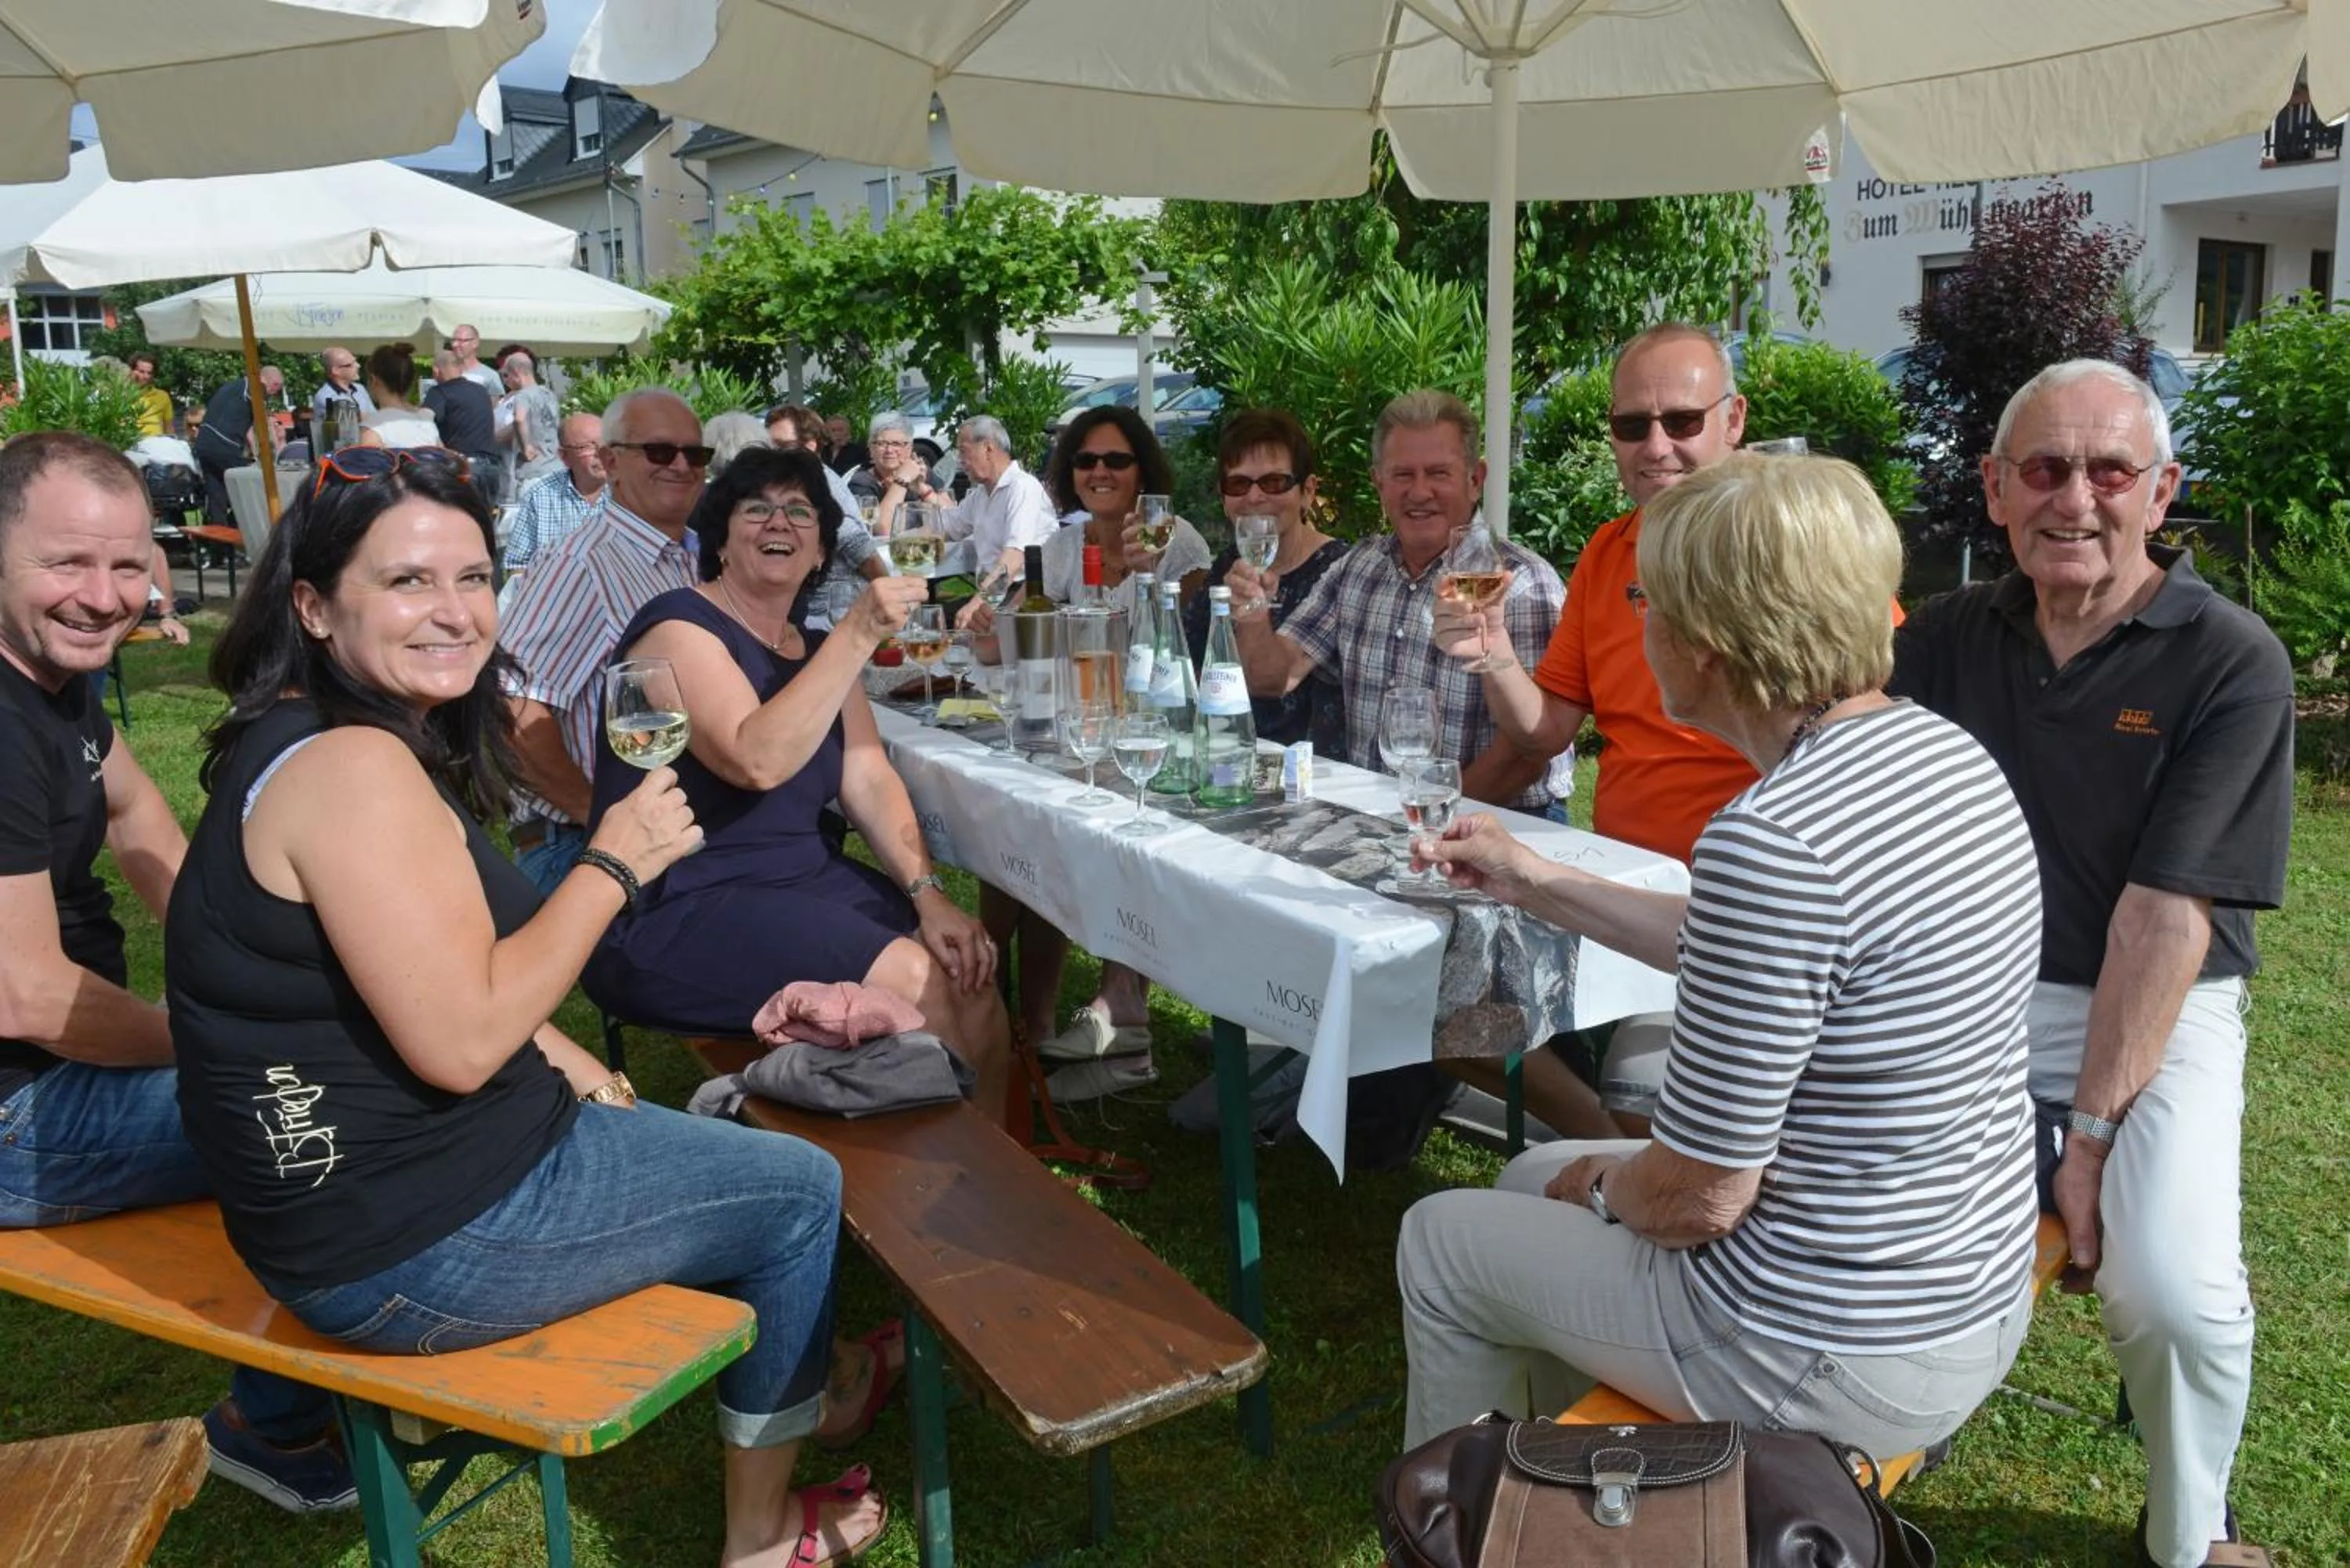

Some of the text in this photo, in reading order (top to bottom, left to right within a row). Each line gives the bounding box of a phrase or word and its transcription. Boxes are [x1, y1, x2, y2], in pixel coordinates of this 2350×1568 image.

[1844, 208, 1898, 242] Zum
[916, 813, 949, 834] OSEL
[1000, 851, 1038, 886] MOSEL
[1116, 906, 1159, 949] MOSEL
[1266, 979, 1323, 1021] MOSE
